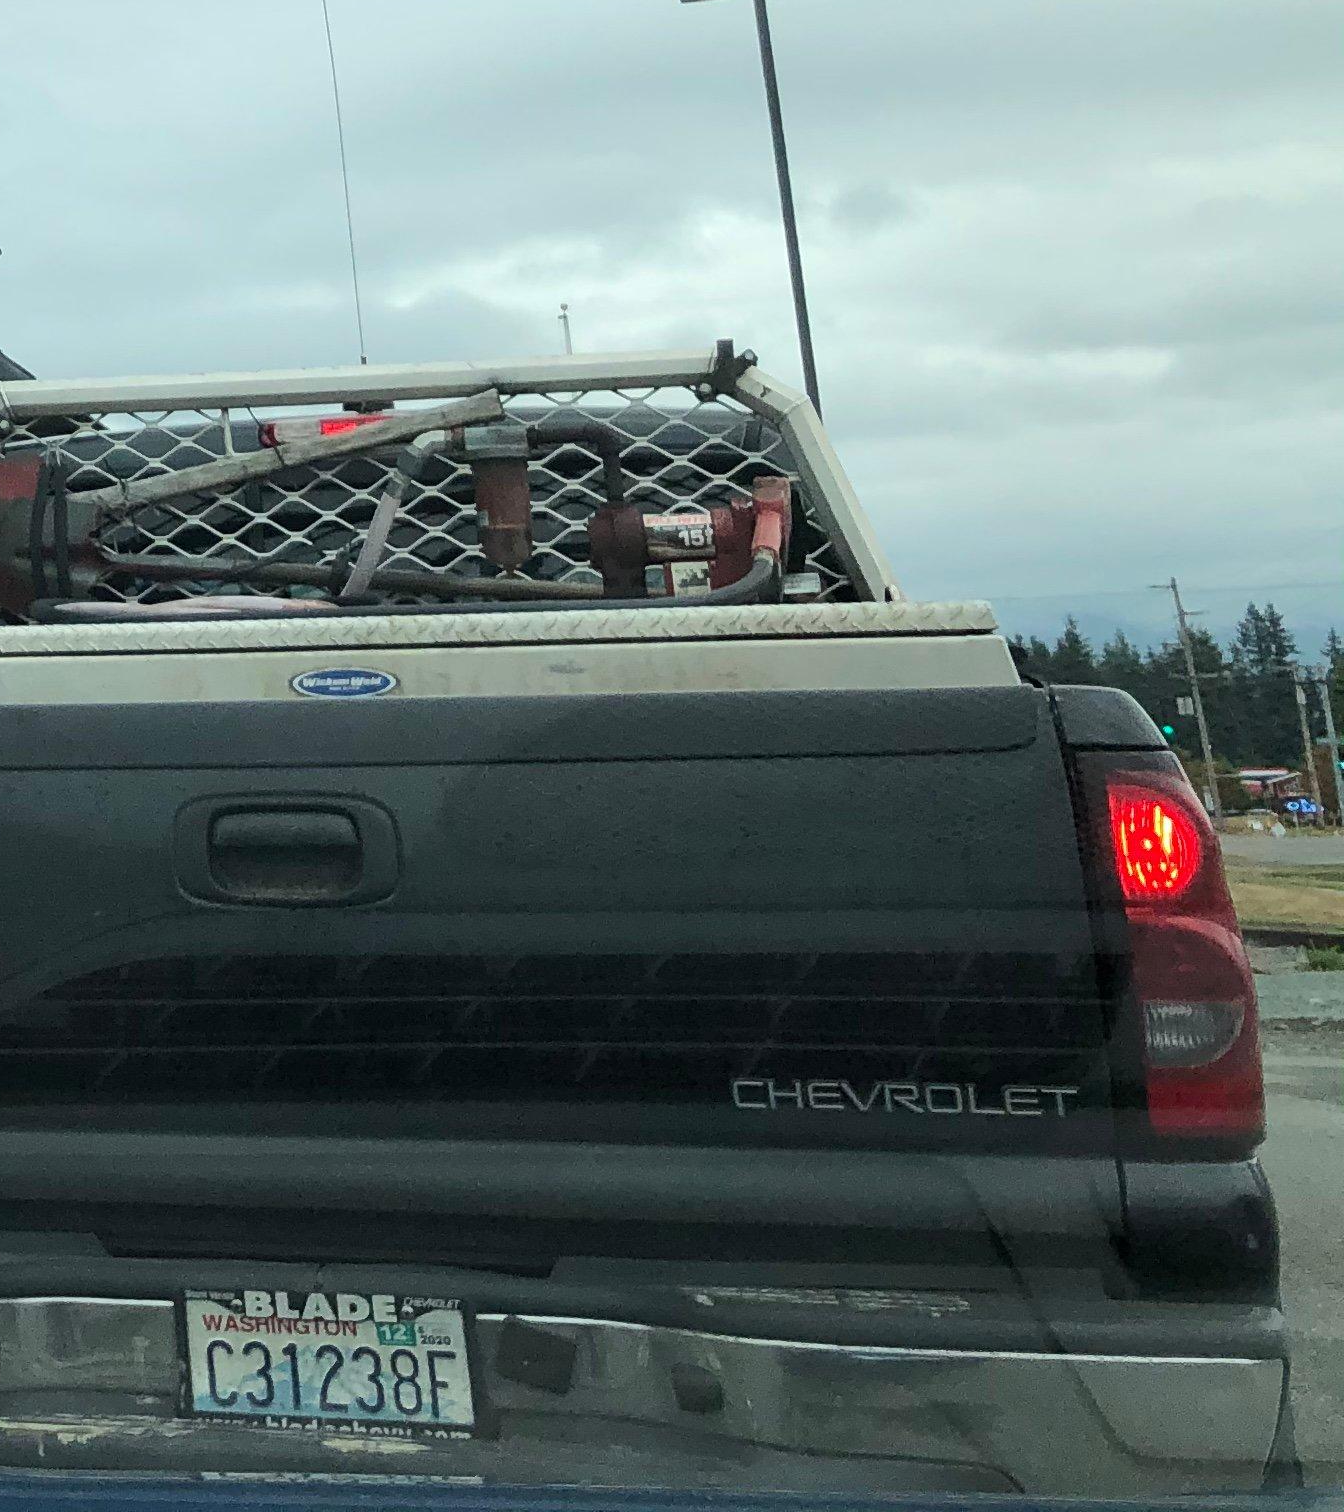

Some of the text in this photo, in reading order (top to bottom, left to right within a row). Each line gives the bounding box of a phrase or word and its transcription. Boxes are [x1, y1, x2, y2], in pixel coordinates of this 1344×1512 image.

[731, 1079, 1078, 1117] CHEVROLET
[243, 1290, 398, 1323] BLADE
[201, 1313, 358, 1337] WASHINGTON
[379, 1323, 408, 1341] 12
[419, 1334, 452, 1346] 2020
[206, 1339, 457, 1419] C31238F
